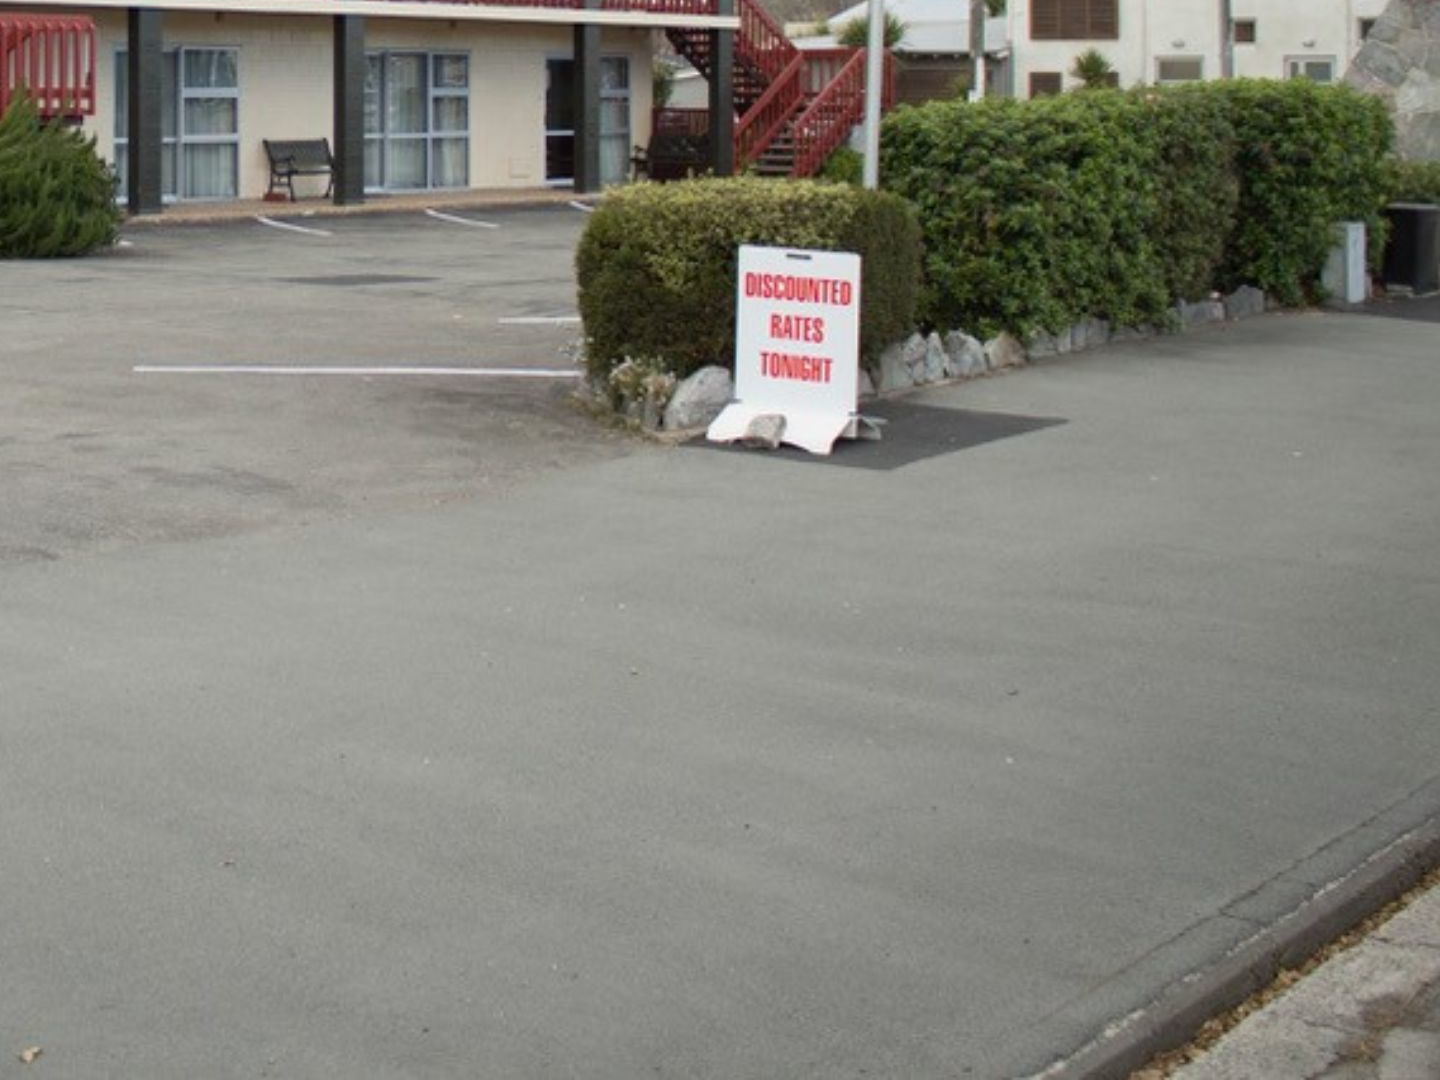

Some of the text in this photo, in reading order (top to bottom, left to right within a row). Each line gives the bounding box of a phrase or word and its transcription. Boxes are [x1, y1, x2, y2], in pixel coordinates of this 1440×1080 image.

[745, 272, 852, 305] DISCOUNTED
[770, 314, 824, 343] RATES
[760, 351, 833, 383] TONIGHT
